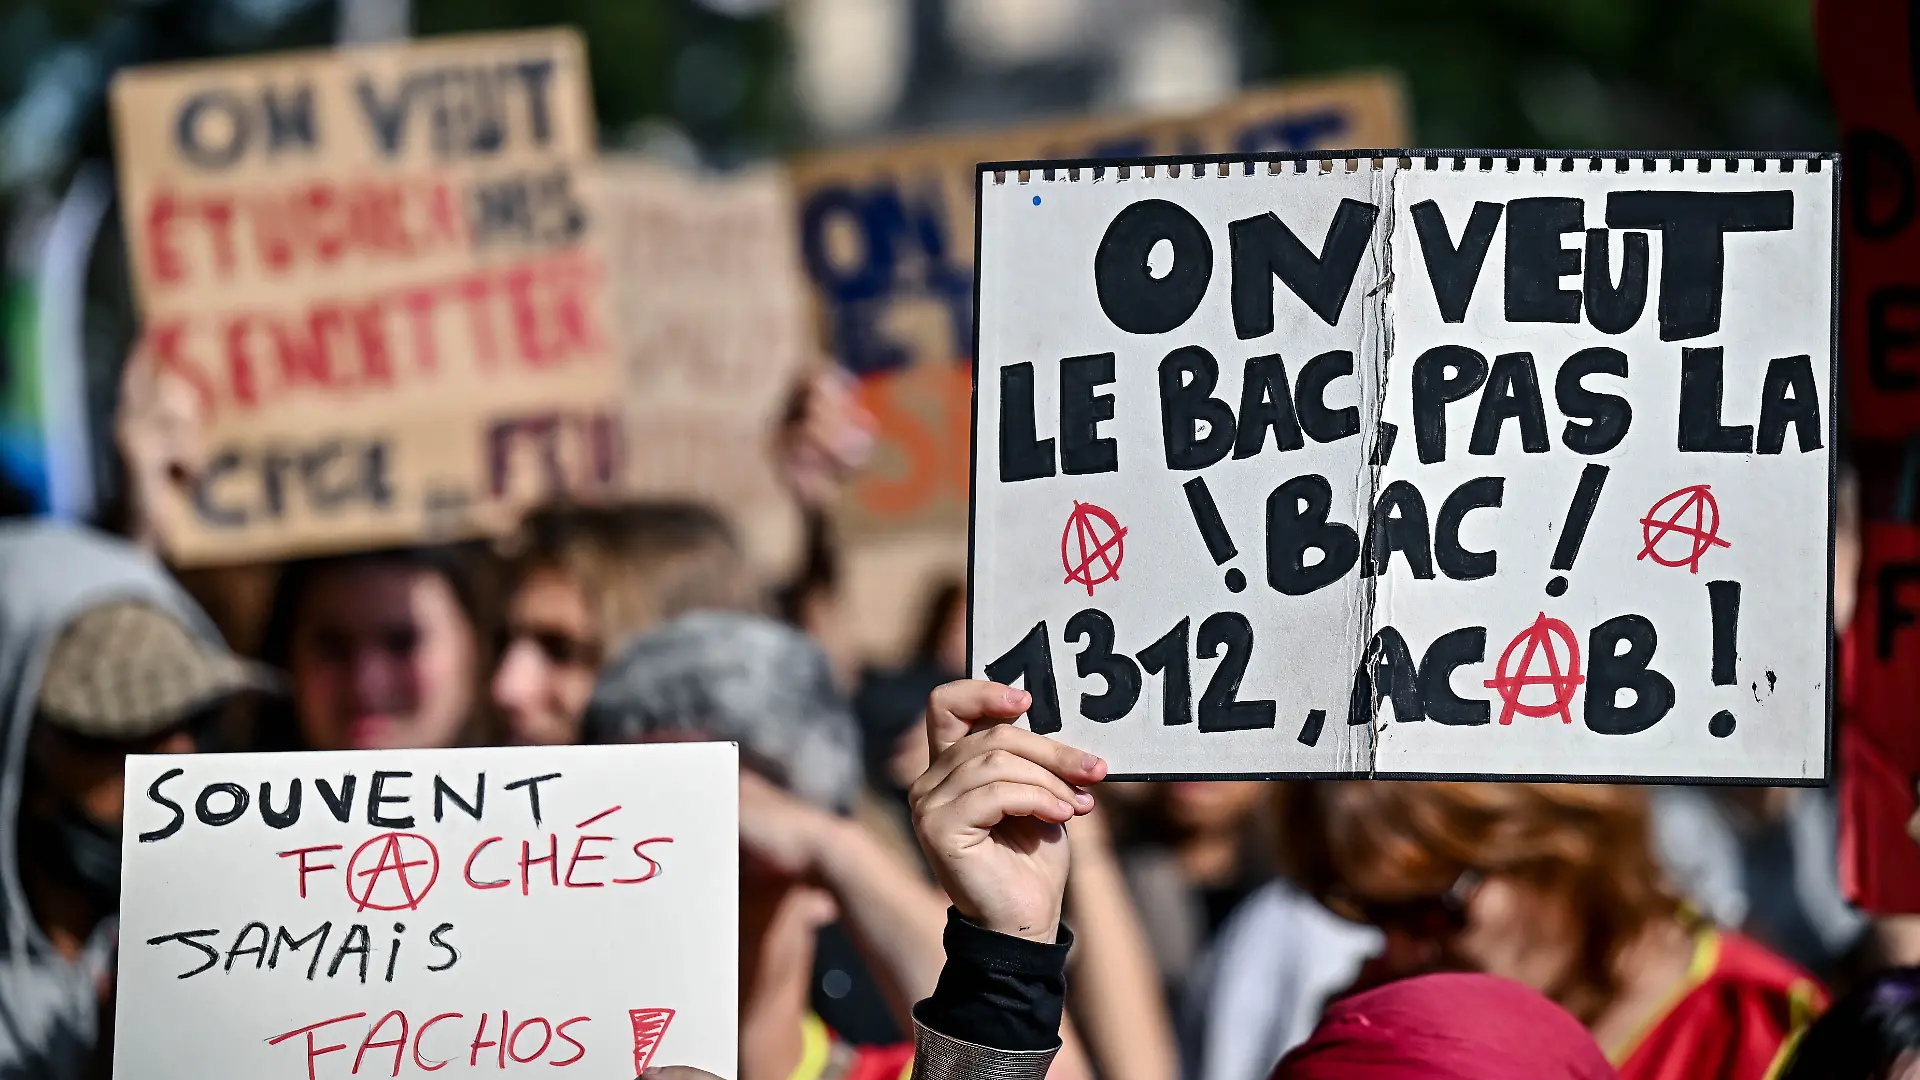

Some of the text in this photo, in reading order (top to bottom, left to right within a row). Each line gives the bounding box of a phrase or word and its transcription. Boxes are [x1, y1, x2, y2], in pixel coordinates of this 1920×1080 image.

[175, 58, 556, 167] ON VEUT
[1095, 198, 1379, 340] ON
[1410, 190, 1794, 342] VEUT
[1000, 352, 1118, 483] LE
[1412, 345, 1632, 464] PAS
[1678, 346, 1824, 455] LA
[1266, 474, 1506, 596] BAC
[139, 767, 562, 843] SOUVENT
[264, 1009, 592, 1080] FACHOS
